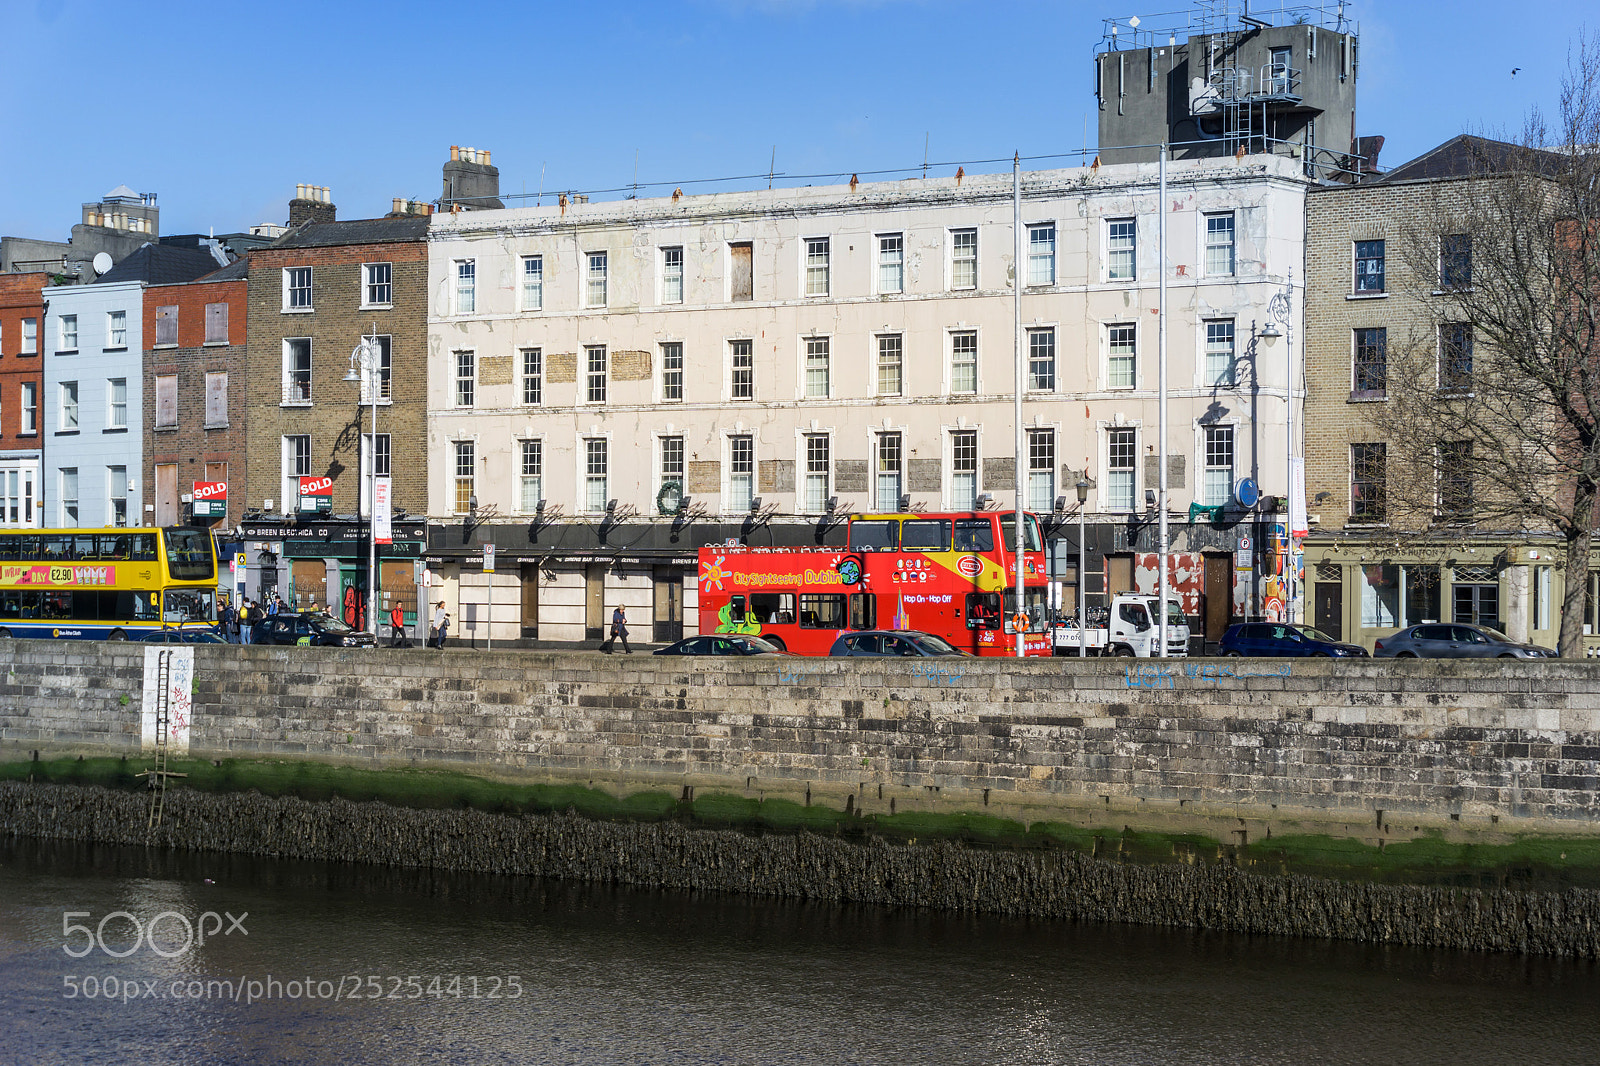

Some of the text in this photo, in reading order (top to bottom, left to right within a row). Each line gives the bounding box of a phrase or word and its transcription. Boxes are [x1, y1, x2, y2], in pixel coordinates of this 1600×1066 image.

[194, 482, 227, 499] SOLD
[300, 477, 332, 494] SOLD
[4, 567, 21, 578] WRAP
[31, 571, 47, 583] DAY
[804, 568, 842, 585] Dublin
[903, 594, 917, 604] Hop
[916, 595, 926, 603] On
[928, 595, 942, 604] Hop
[941, 594, 952, 603] Off
